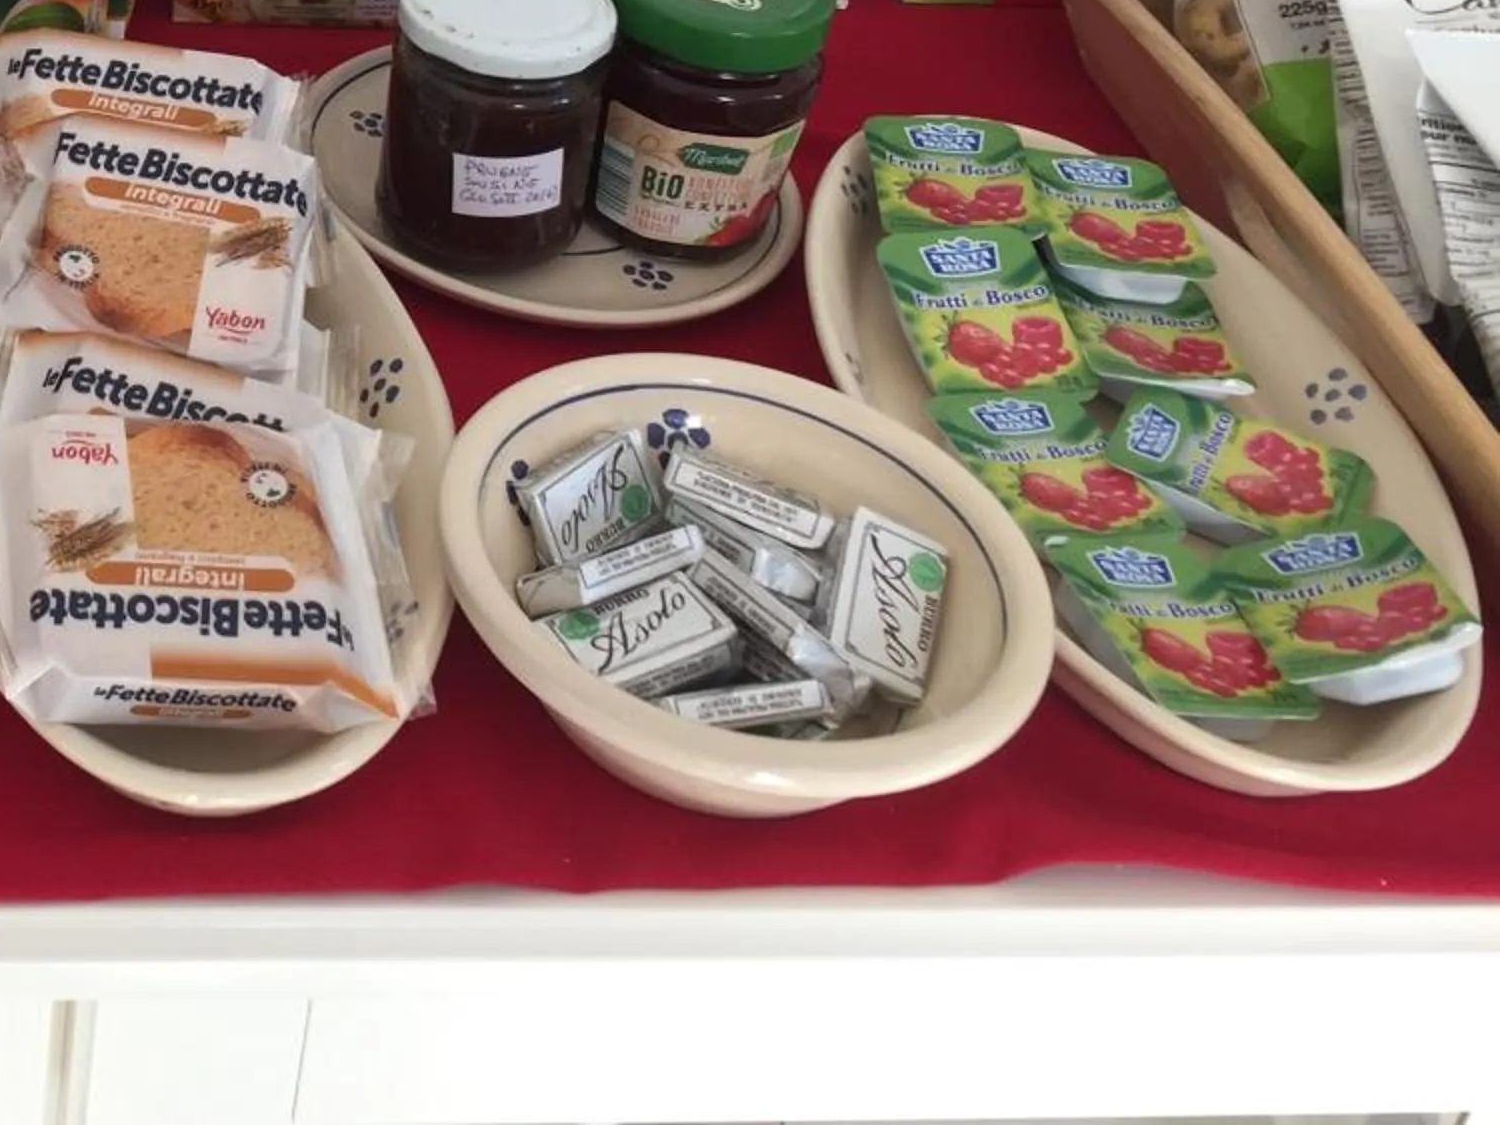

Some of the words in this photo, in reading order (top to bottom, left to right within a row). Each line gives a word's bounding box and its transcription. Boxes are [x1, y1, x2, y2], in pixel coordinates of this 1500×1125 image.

[1279, 0, 1329, 19] 225g
[888, 153, 941, 172] Frutti
[960, 161, 1023, 176] Bosco
[685, 201, 748, 212] EXTRA
[1114, 197, 1178, 212] Bosco
[914, 290, 967, 309] Frutti
[985, 284, 1050, 306] Bosco
[206, 306, 266, 331] Yabon
[1200, 413, 1234, 455] Bosco
[51, 446, 121, 466] Yabon
[1047, 439, 1109, 460] Bosco
[561, 443, 629, 555] Asolo
[584, 517, 628, 555] BURRO
[1255, 583, 1325, 605] Frutti
[1347, 556, 1418, 588] Bosco
[870, 533, 922, 670] Asolo
[1167, 602, 1235, 620] Bosco
[590, 588, 687, 675] Asolo
[916, 593, 938, 652] BURRO
